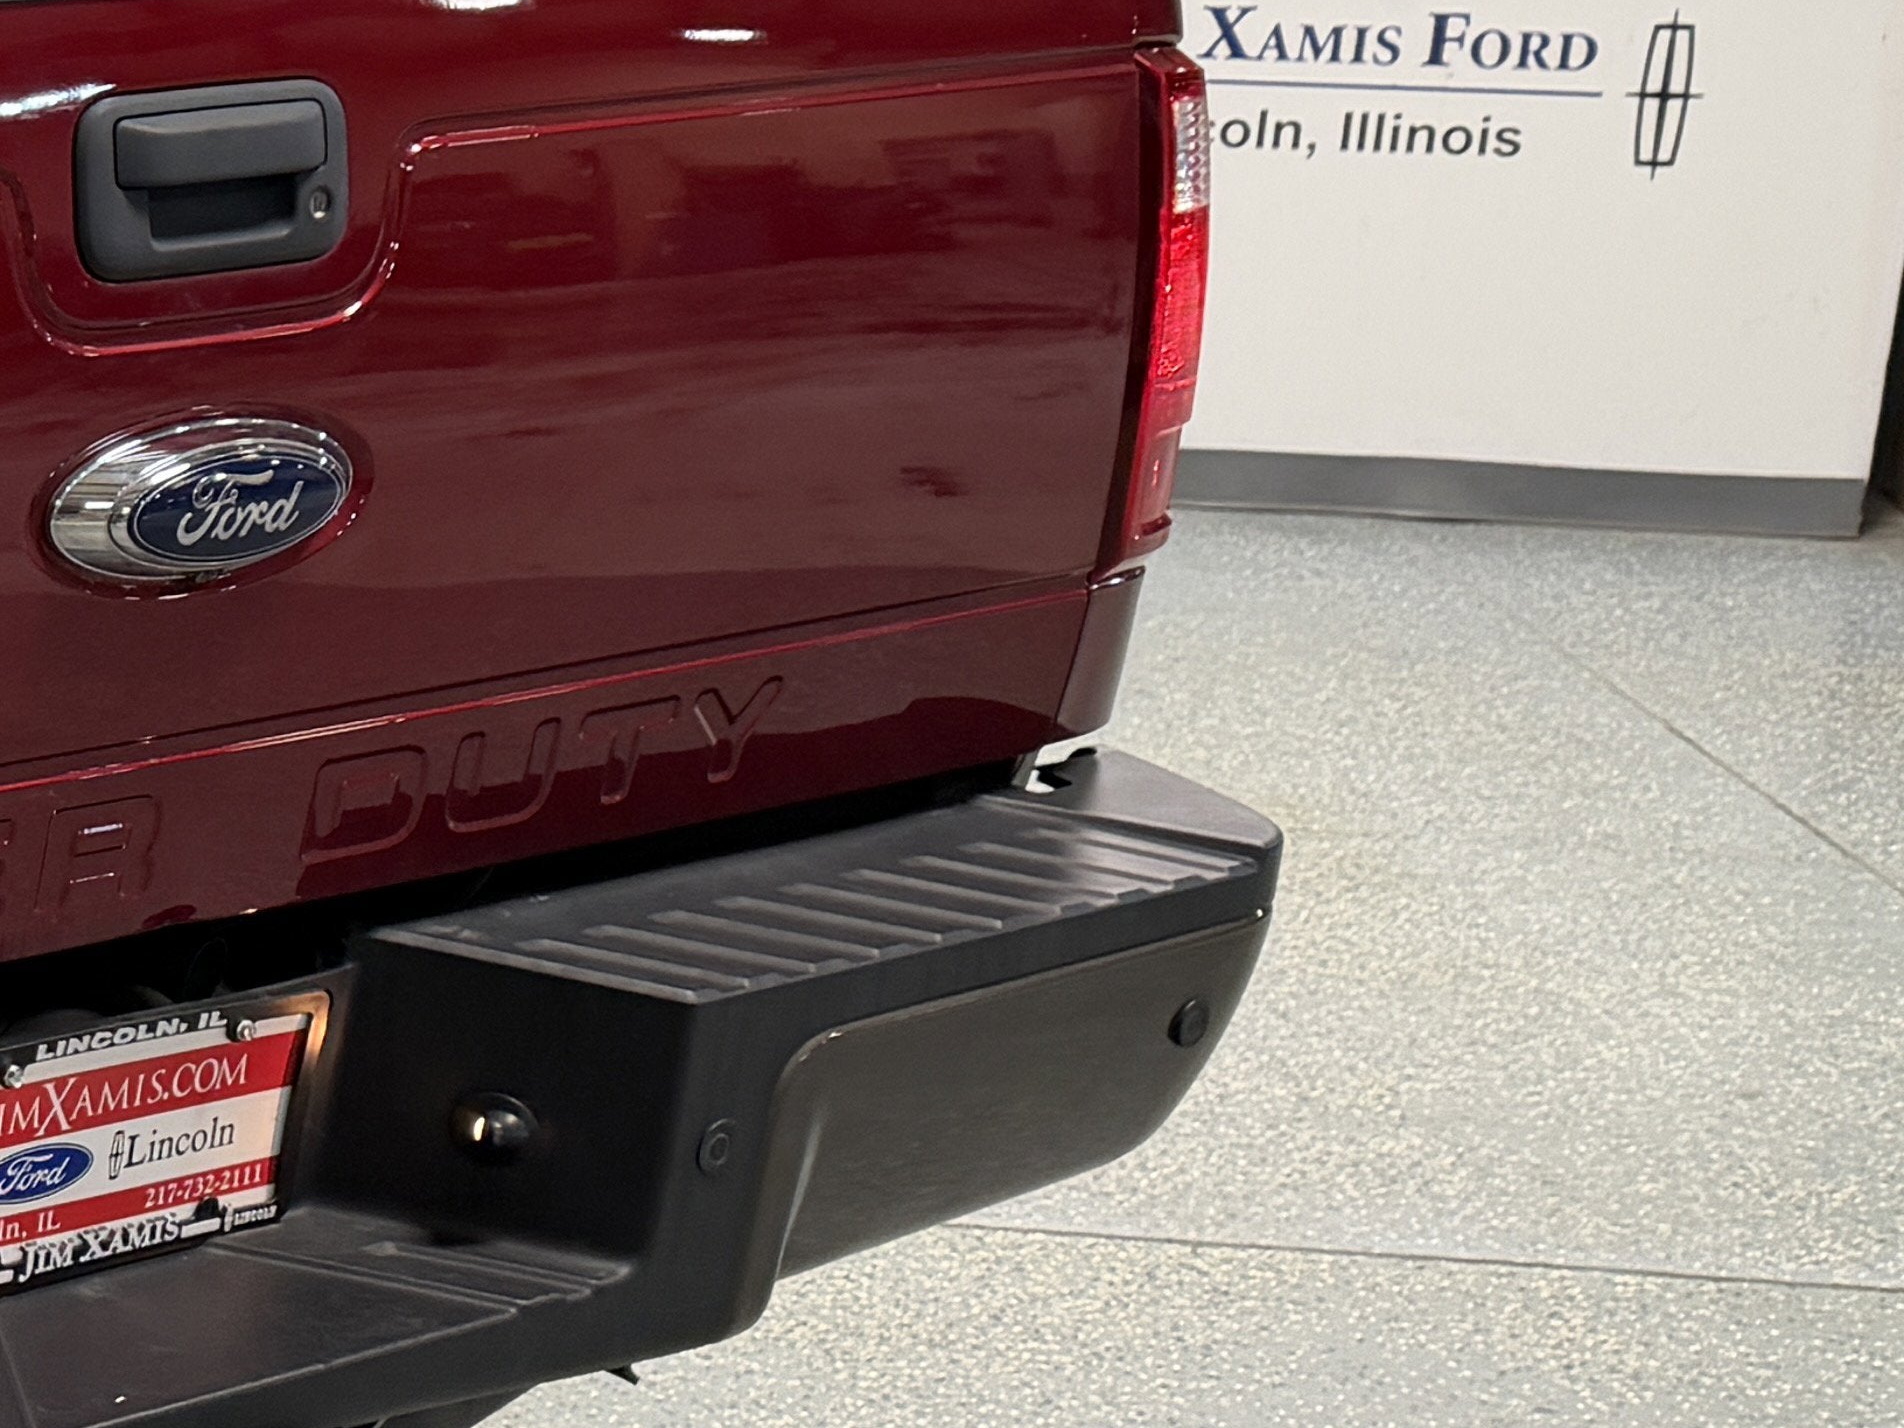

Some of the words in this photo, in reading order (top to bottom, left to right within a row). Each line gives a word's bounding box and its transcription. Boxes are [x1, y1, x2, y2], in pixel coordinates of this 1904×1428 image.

[1196, 5, 1403, 67] XAMIS
[1421, 12, 1600, 73] FORD
[1208, 109, 1318, 159] oln,
[1339, 112, 1523, 157] Illinois
[175, 469, 305, 547] Ford
[297, 674, 788, 866] DUTY
[34, 1016, 189, 1063] LINCOLN,
[197, 1010, 229, 1030] IL
[122, 1116, 237, 1169] Lincoln
[143, 1163, 264, 1209] 217-732-2111
[37, 1210, 62, 1232] IL
[18, 1243, 77, 1282] JIM
[79, 1217, 181, 1264] XAMIS
